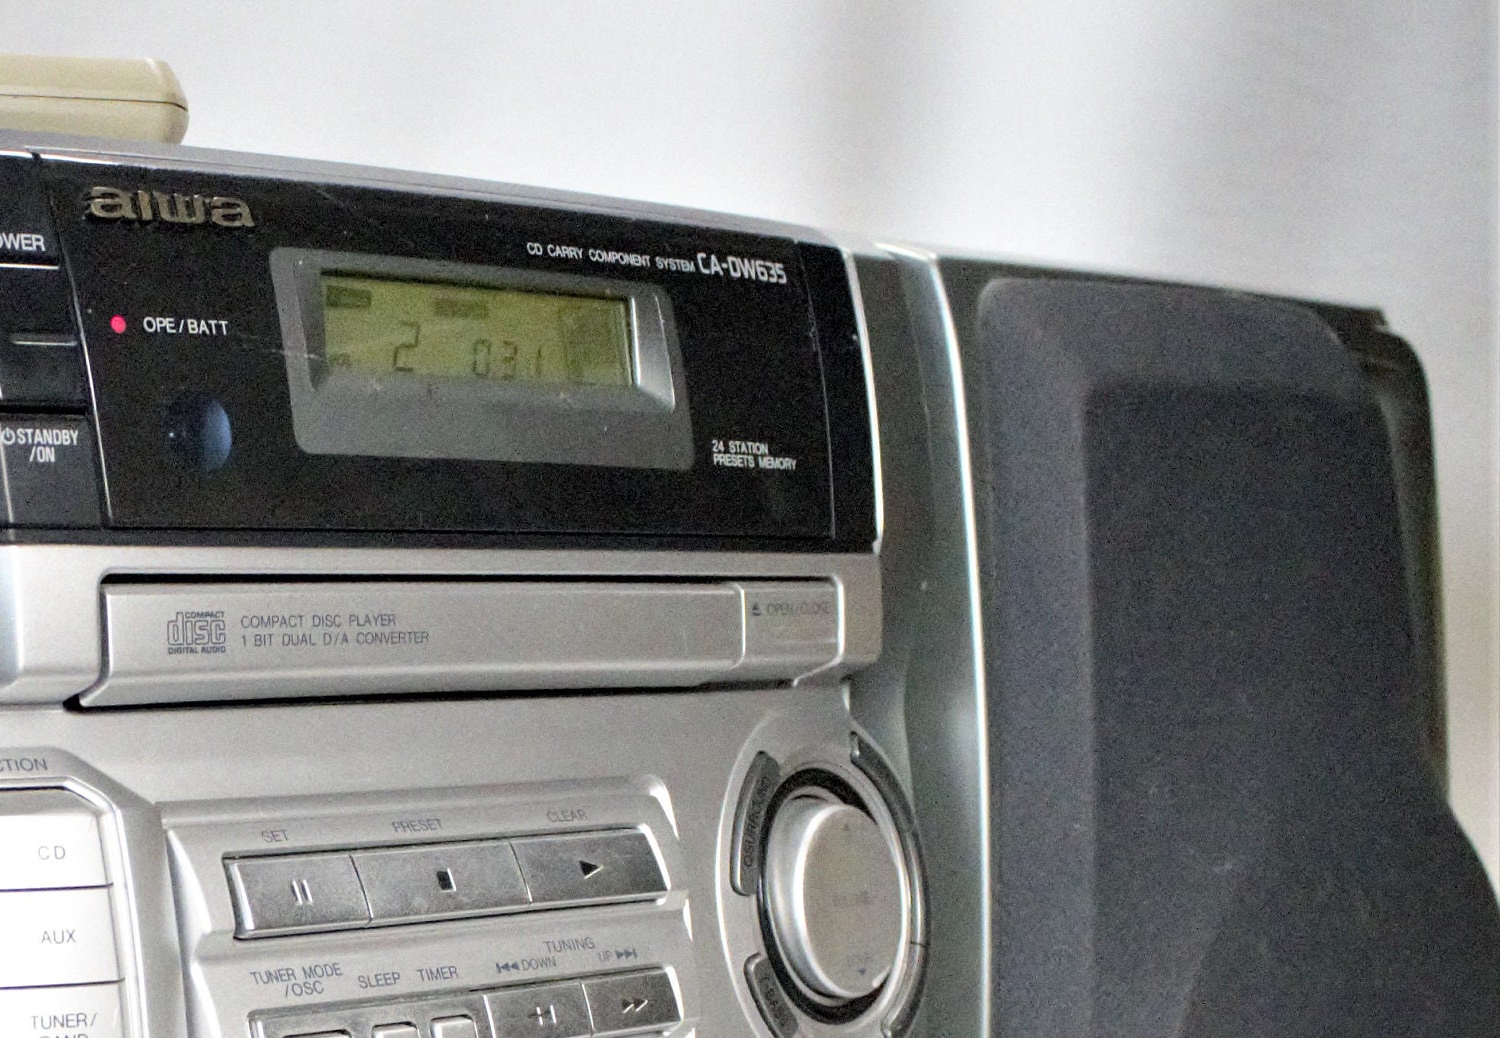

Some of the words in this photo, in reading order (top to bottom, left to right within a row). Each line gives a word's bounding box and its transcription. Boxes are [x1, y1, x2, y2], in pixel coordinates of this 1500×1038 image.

[87, 186, 255, 227] aiwa
[526, 242, 543, 255] CD
[546, 245, 583, 259] CARRY
[589, 249, 650, 267] COMPONENT
[655, 256, 695, 272] SYSTEM
[697, 252, 787, 284] CA-DW635
[17, 429, 78, 446] STANDBY
[29, 447, 56, 463] /ON
[712, 439, 724, 453] 24
[729, 440, 769, 455] STATION
[713, 453, 755, 468] PRESETS
[759, 456, 797, 471] MEMORY
[184, 611, 225, 619] COMPACT
[240, 615, 304, 629] COMPACT
[312, 614, 342, 628] DISC
[349, 613, 397, 627] PLAYER
[241, 635, 247, 648] 1
[254, 634, 273, 647] BIT
[282, 633, 316, 647] DUAL
[323, 632, 349, 646] D/A
[356, 631, 430, 646] CONVERTER
[167, 646, 199, 654] DIGITAL
[201, 646, 227, 654] AUDIO
[546, 808, 587, 824] CLEAR
[392, 818, 442, 834] PRESET
[261, 829, 289, 844] SET
[37, 845, 66, 861] CD
[40, 929, 76, 945] AUX
[543, 937, 596, 953] TUNING
[521, 956, 557, 971] DOWN
[598, 950, 612, 962] UP
[249, 968, 297, 987] TUNER
[301, 962, 344, 981] MODE
[358, 970, 401, 989] SLEEP
[416, 965, 458, 982] TIMER
[284, 980, 325, 998] /OSC
[30, 1012, 97, 1031] TUNER/
